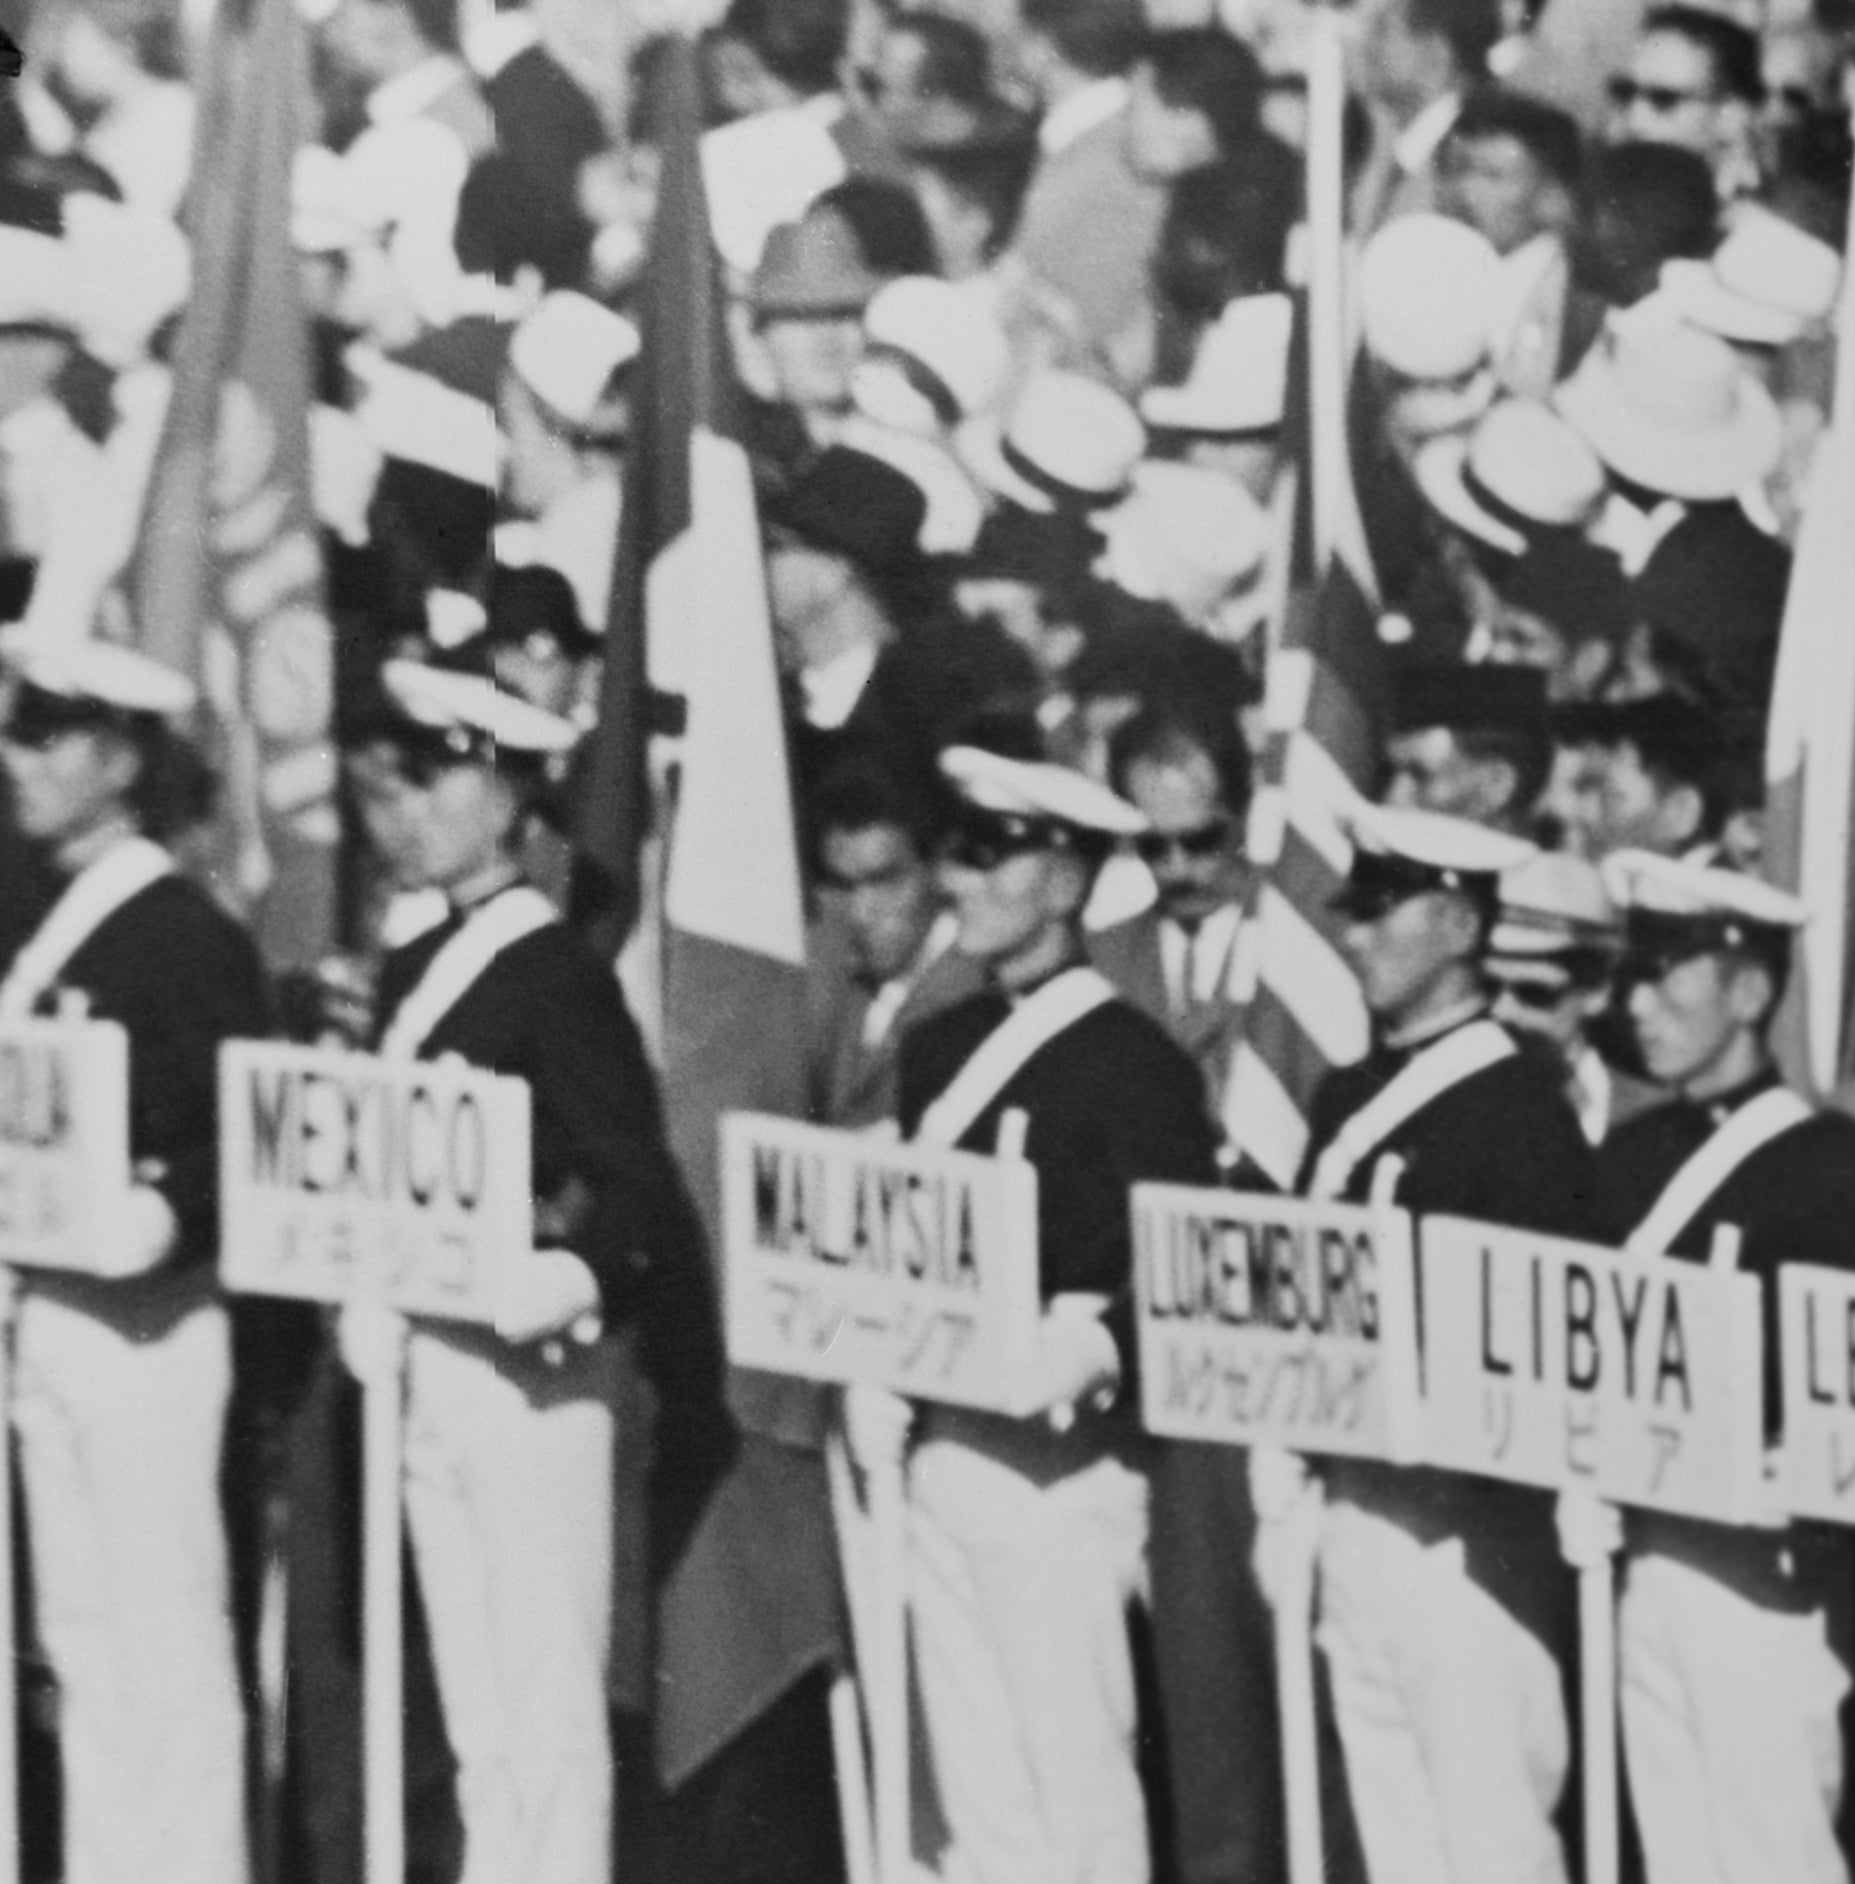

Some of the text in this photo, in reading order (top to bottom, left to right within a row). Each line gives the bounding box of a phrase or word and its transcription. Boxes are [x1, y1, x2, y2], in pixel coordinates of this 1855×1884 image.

[249, 1067, 487, 1212] MEXICO
[752, 1143, 982, 1294] MALAYSIA
[1481, 1246, 1691, 1414] LIBYA
[1483, 1386, 1682, 1495] リビア
